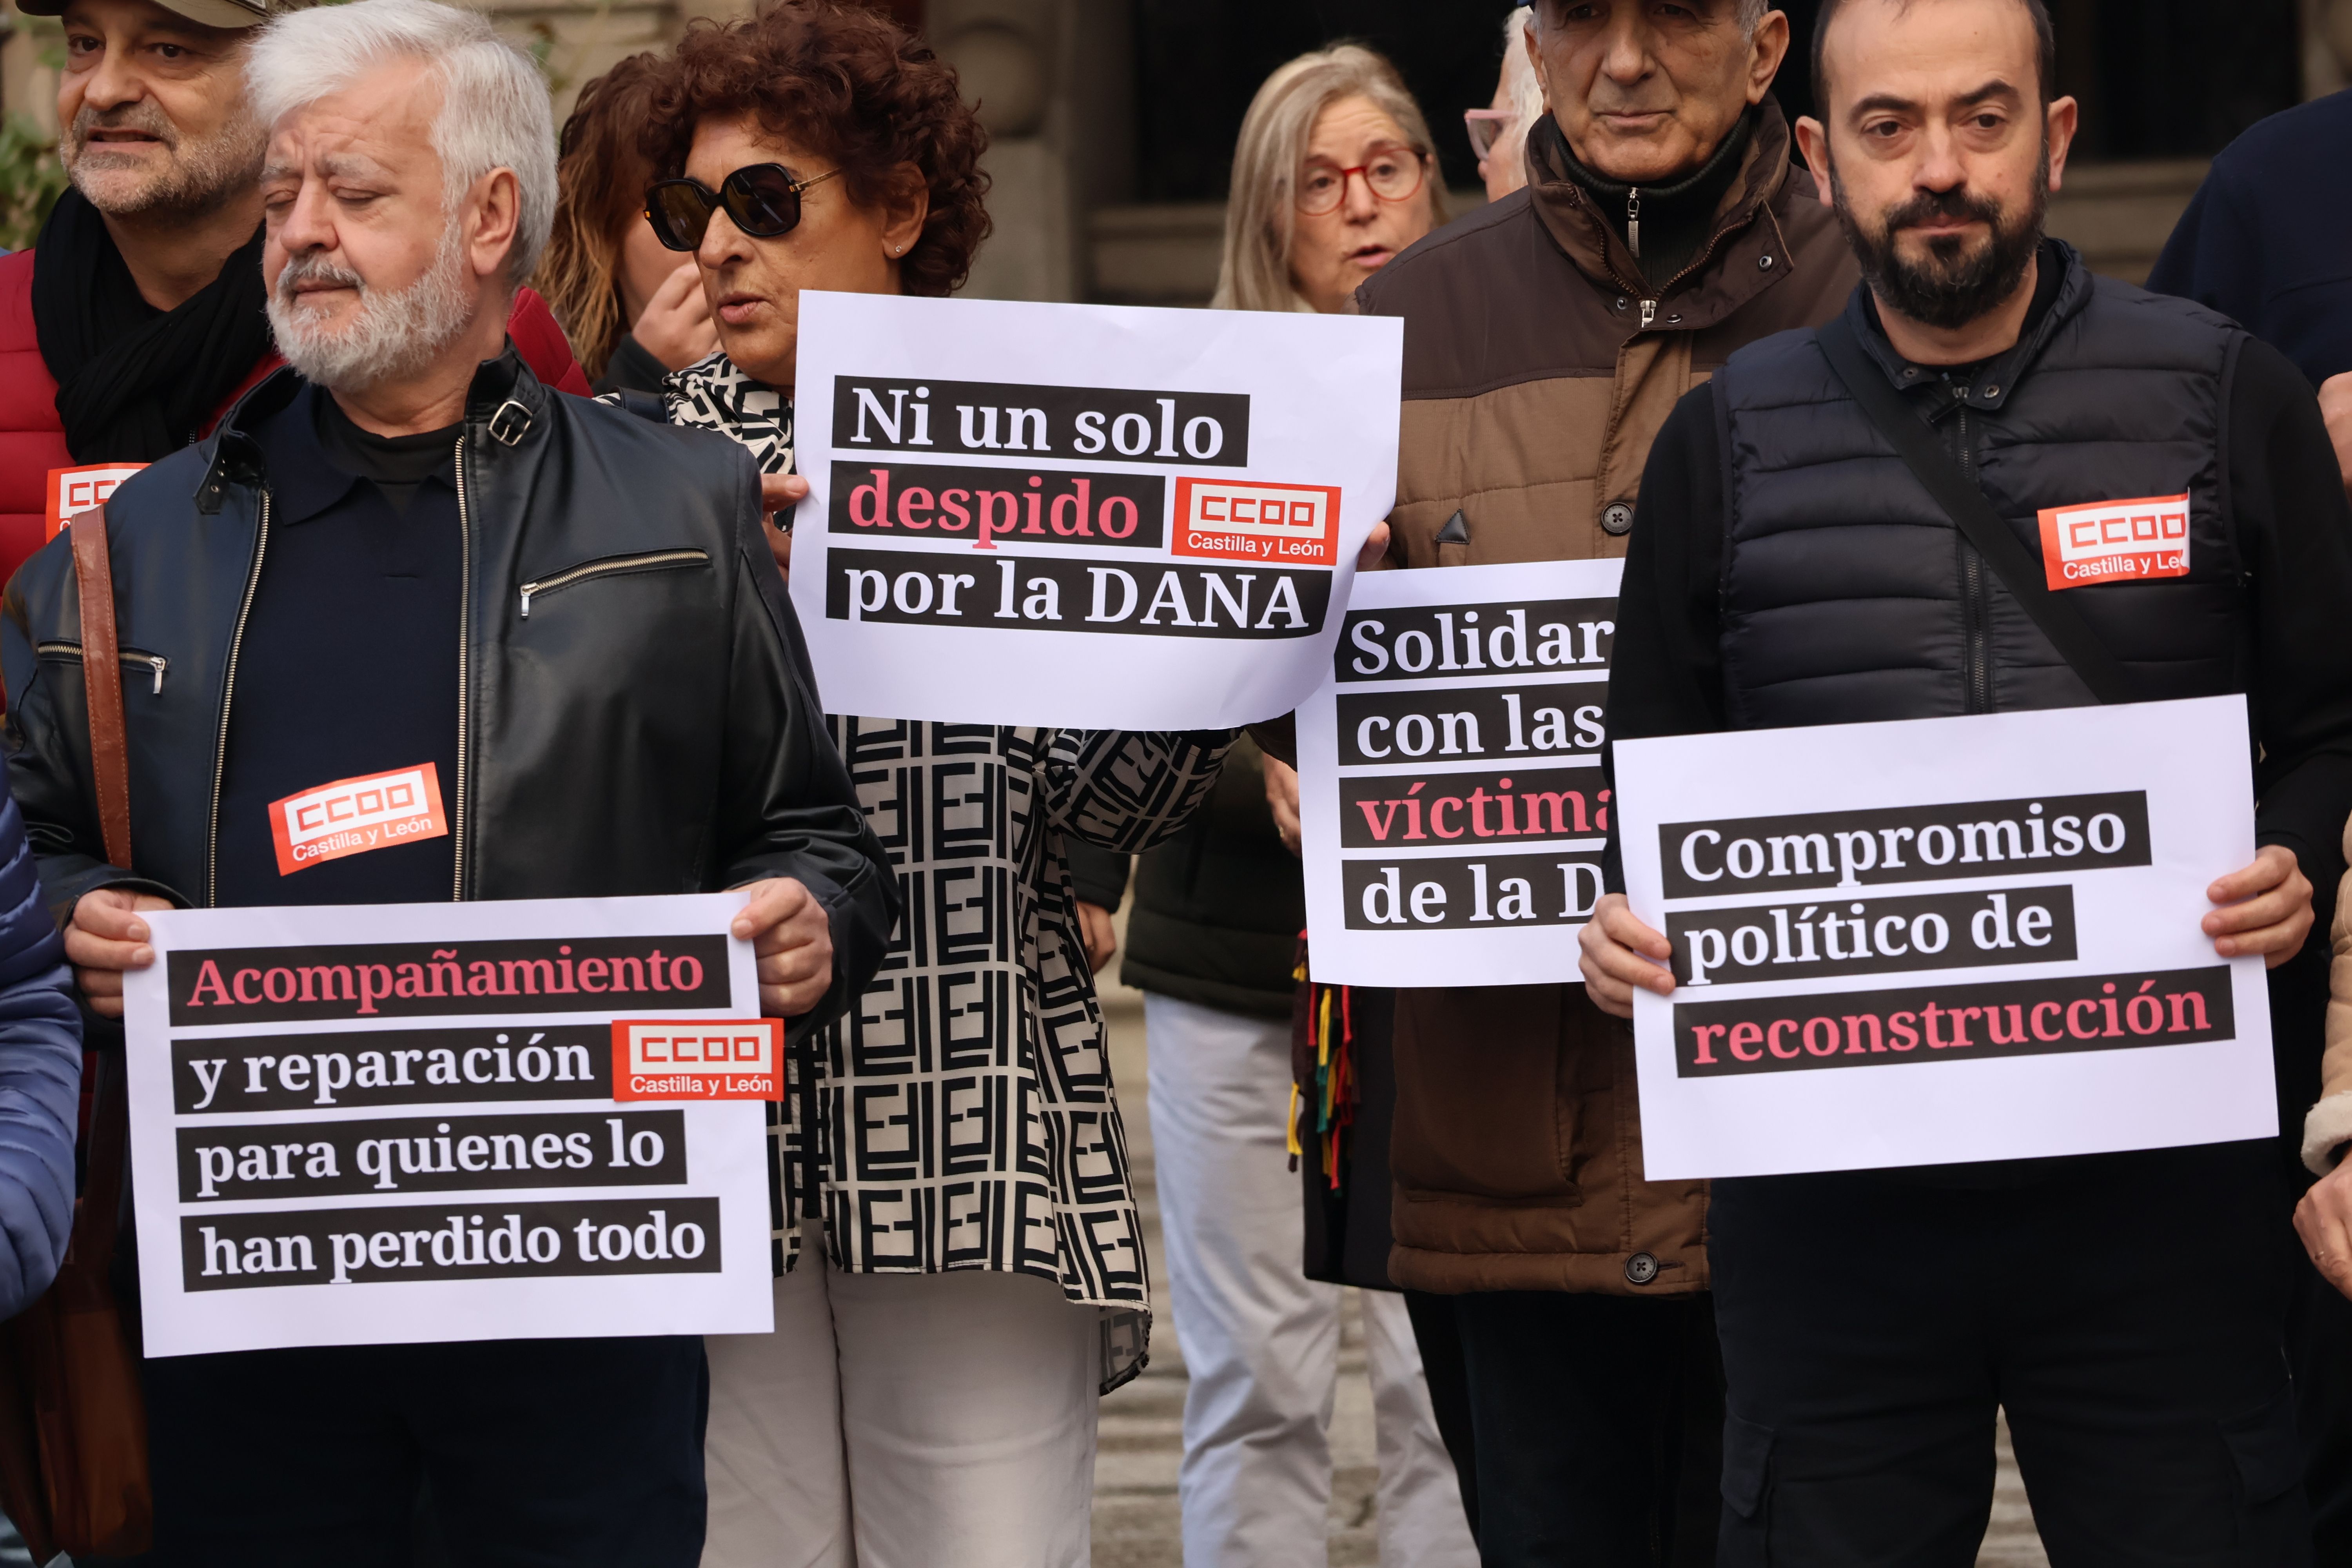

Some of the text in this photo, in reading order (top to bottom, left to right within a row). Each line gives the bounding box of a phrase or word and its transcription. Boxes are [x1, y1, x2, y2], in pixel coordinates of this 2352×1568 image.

[851, 387, 1223, 459] Ni un solo
[69, 480, 125, 507] CC
[849, 470, 1138, 549] despido
[1201, 495, 1315, 527] CCOO
[1188, 533, 1323, 557] Castilla y León
[2069, 513, 2186, 548] CCOO
[845, 560, 1308, 628] por la DANA
[2063, 555, 2135, 579] Castilla
[2139, 557, 2151, 574] y
[1352, 609, 1615, 673] Solidar
[1358, 694, 1604, 757] con las
[293, 817, 432, 861] Castilla y León
[296, 783, 414, 832] CCOO
[1681, 803, 2125, 886] Compromiso
[1363, 867, 1446, 924] de
[1468, 864, 1536, 921] la
[1684, 893, 2052, 985] político de
[187, 946, 702, 1013] Acompañamiento
[641, 1036, 759, 1062] CCOO
[1692, 980, 2211, 1063] reconstrucción
[189, 1033, 594, 1109] y reparación
[630, 1075, 773, 1096] Castilla y León
[196, 1119, 664, 1197] para quienes lo
[200, 1210, 705, 1283] han perdido todo
